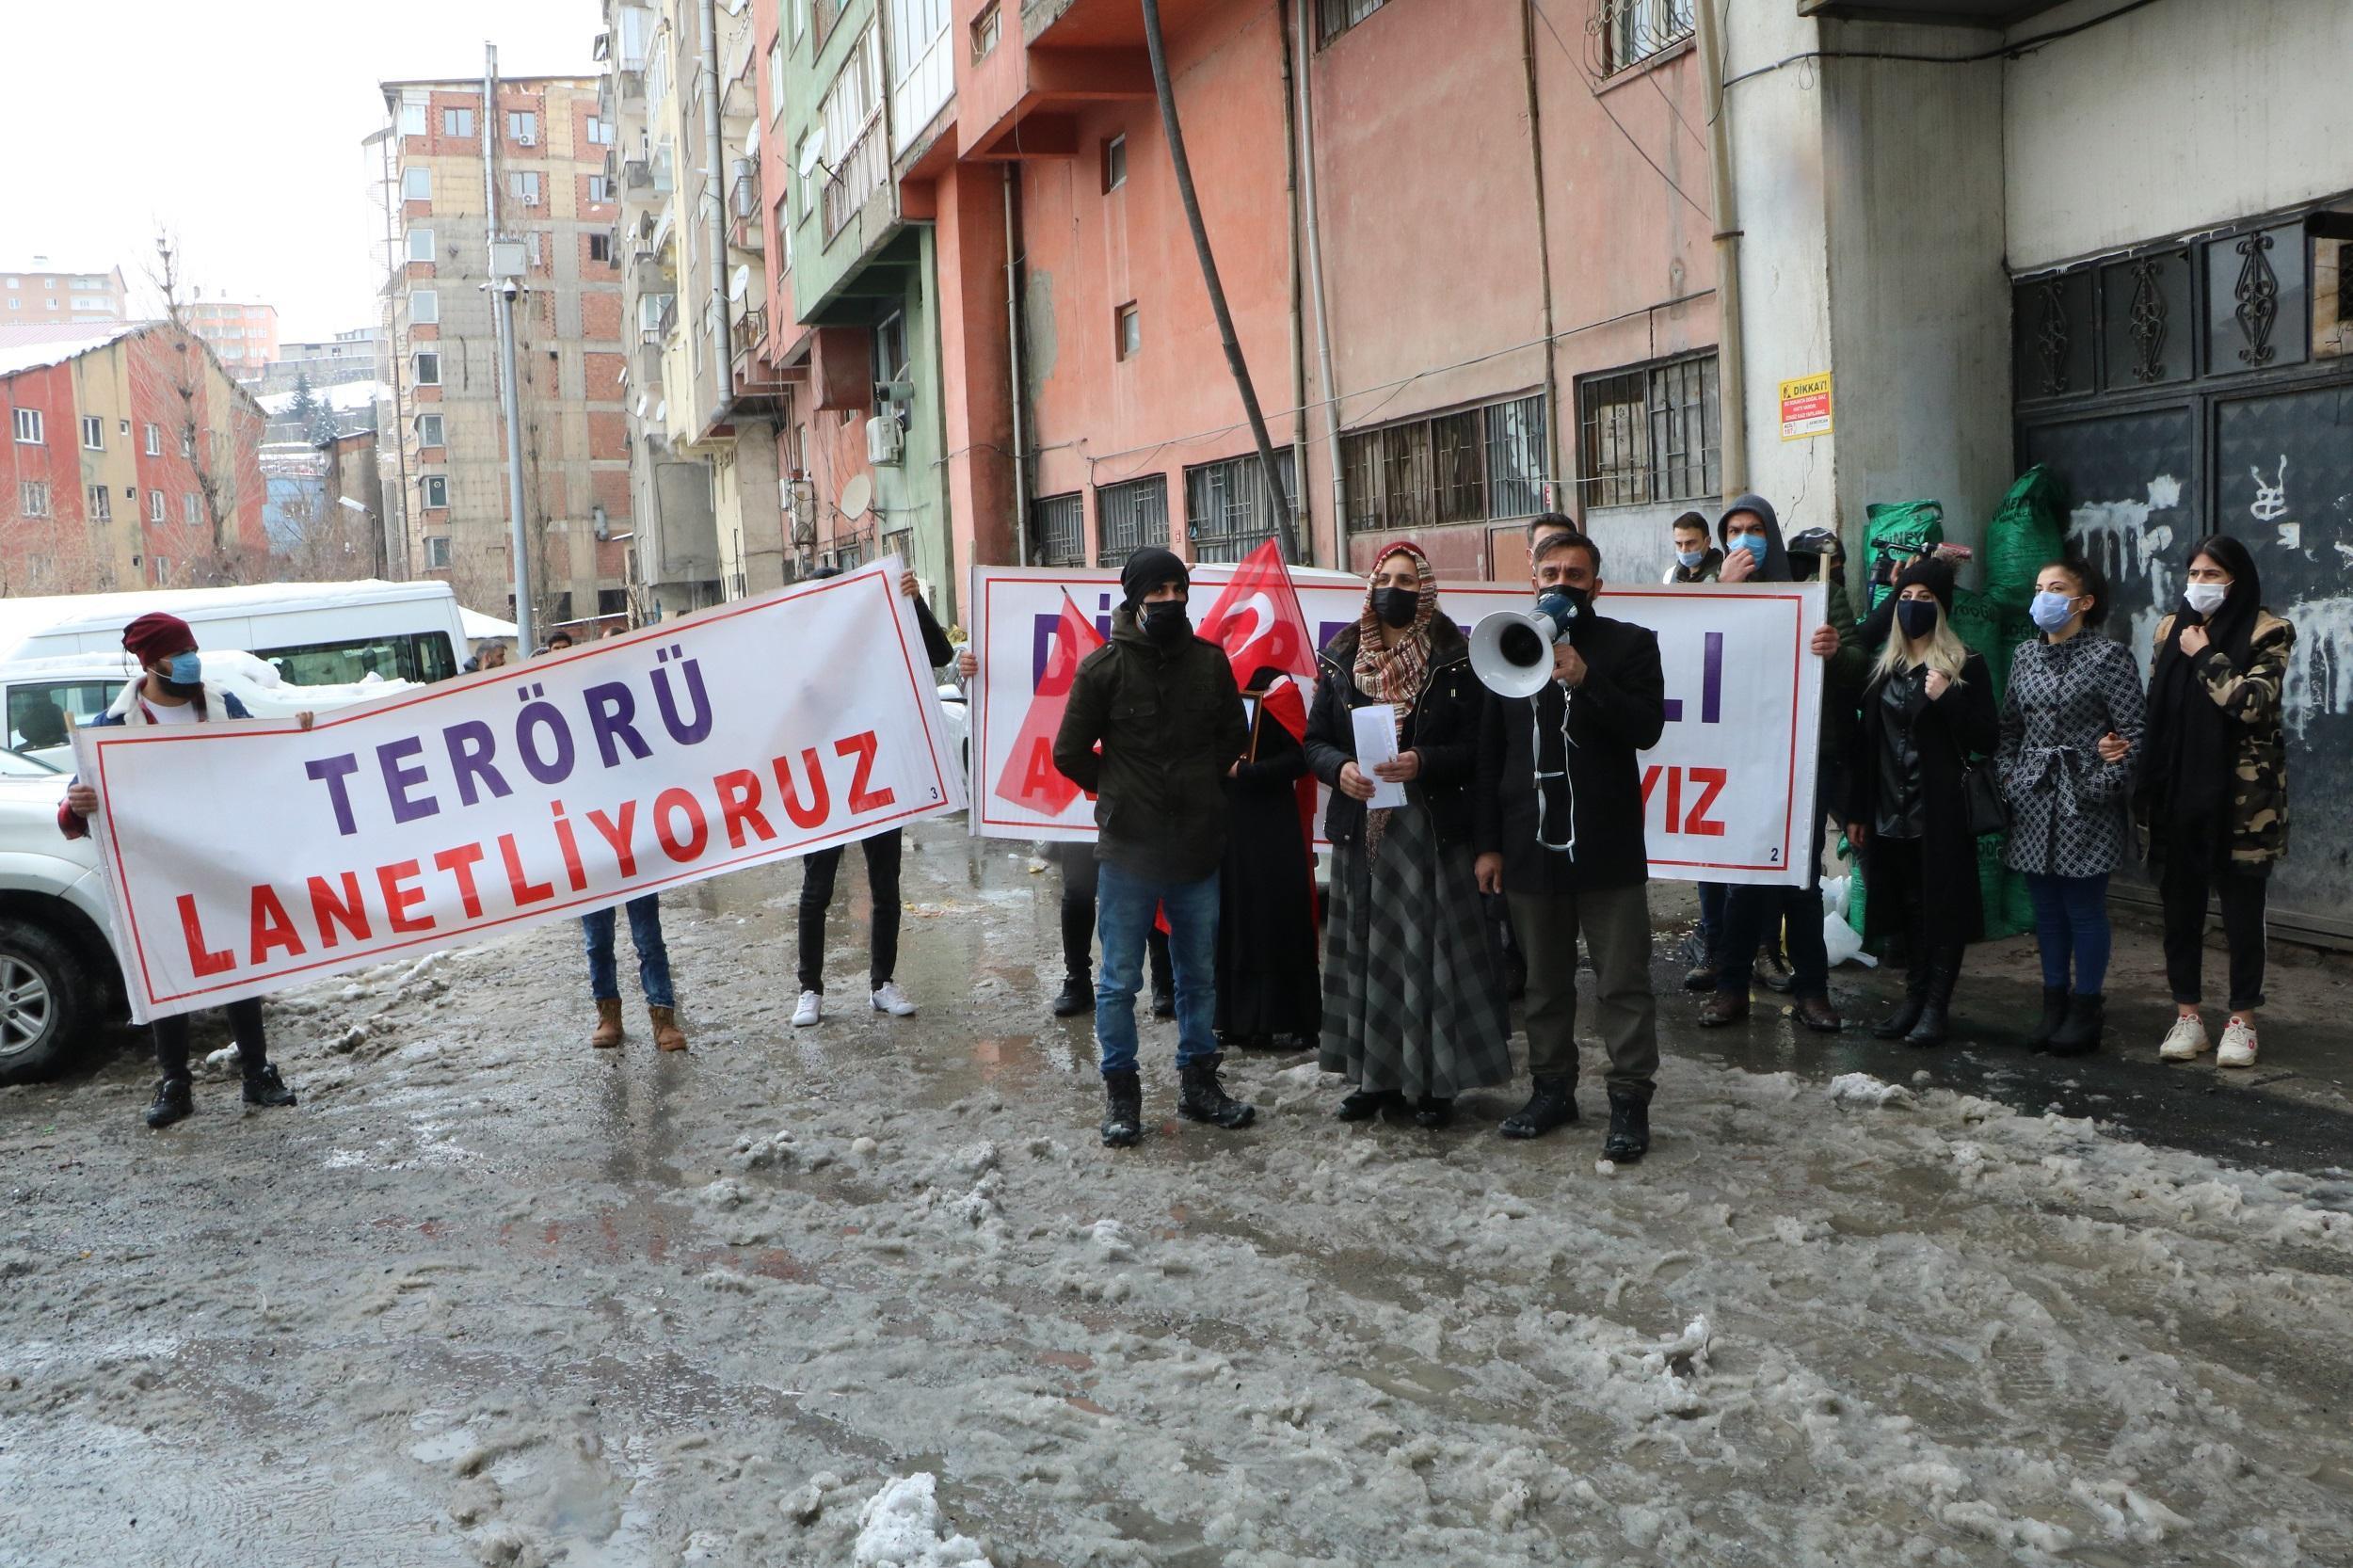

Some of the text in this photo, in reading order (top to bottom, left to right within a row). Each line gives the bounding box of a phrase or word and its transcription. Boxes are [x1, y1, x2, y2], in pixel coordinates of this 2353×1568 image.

[1794, 380, 1827, 395] DİKKAT!
[305, 644, 713, 835] TERÖRÜ
[931, 787, 937, 799] 3
[176, 730, 895, 978] LANETLİYORUZ
[1770, 848, 1778, 861] 2
